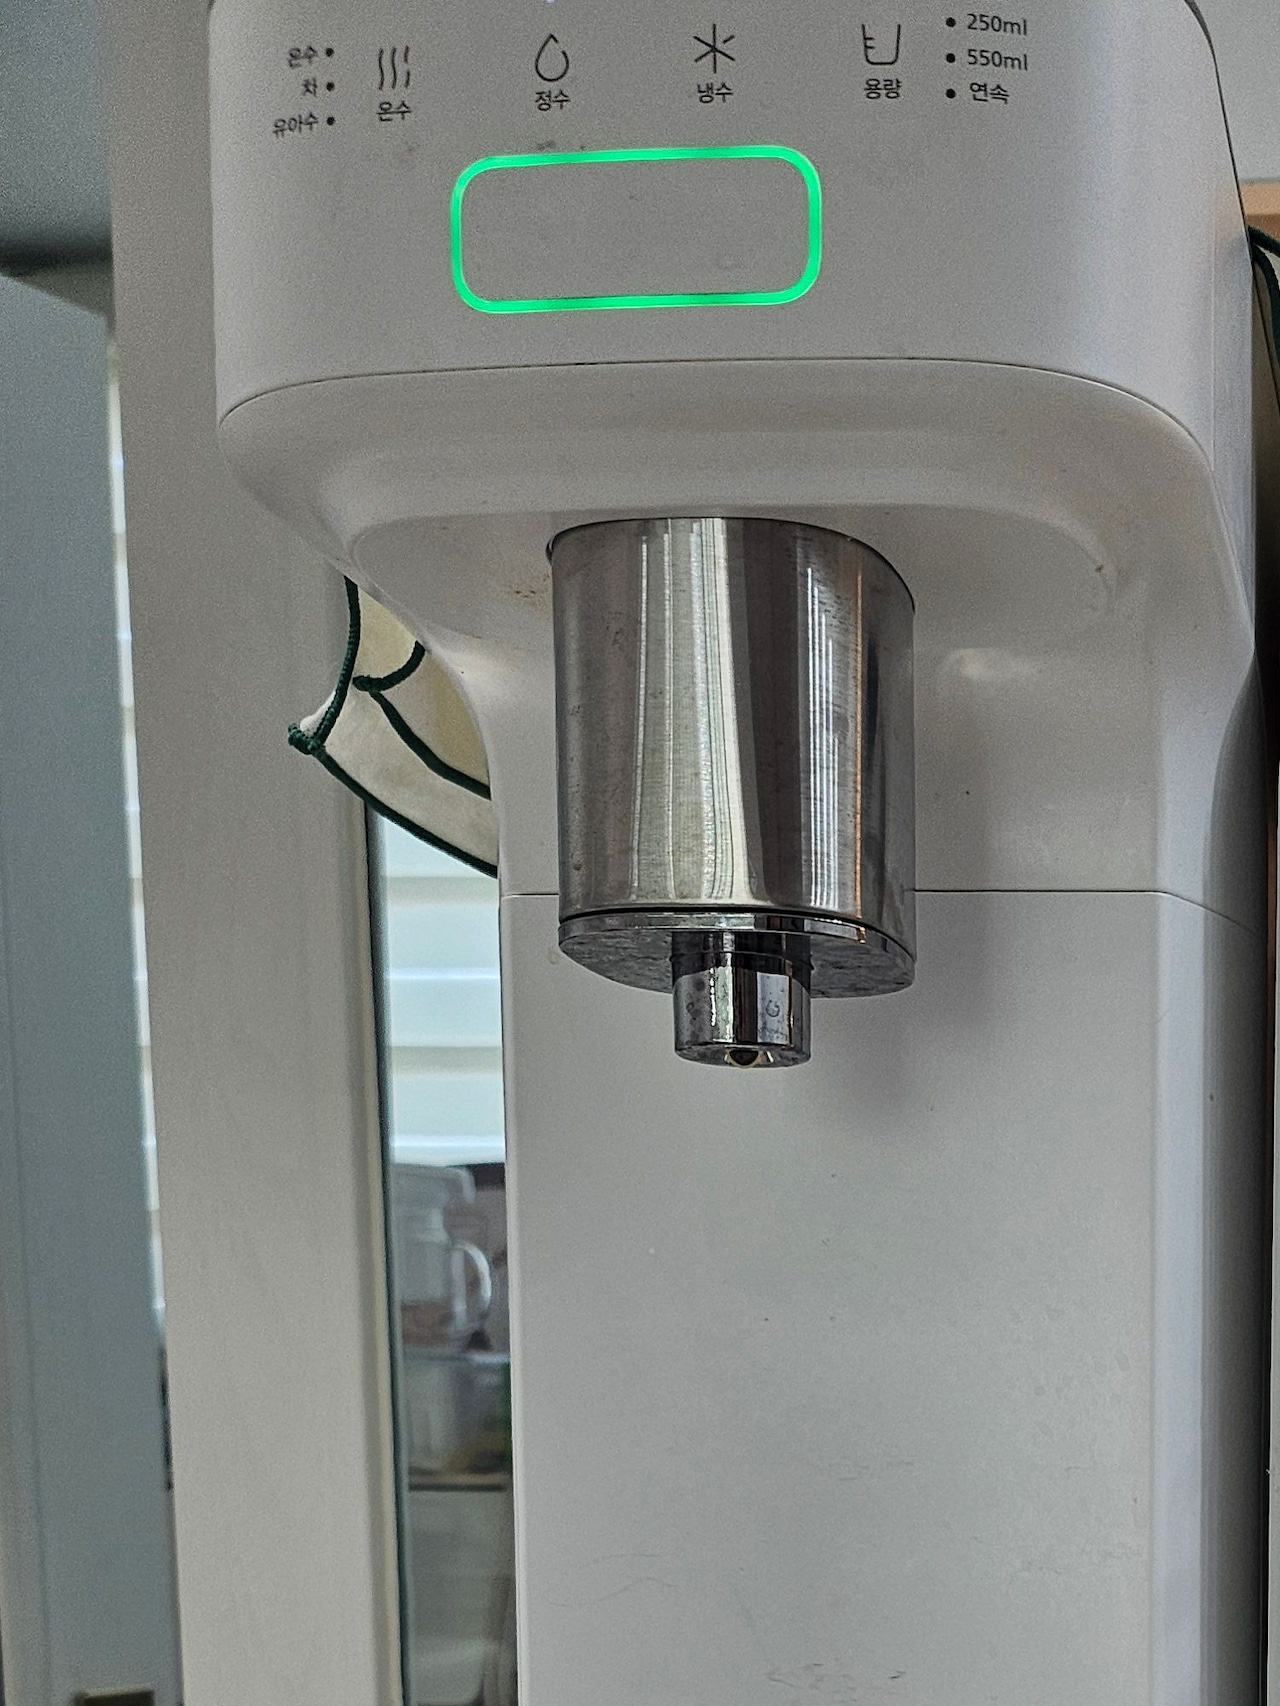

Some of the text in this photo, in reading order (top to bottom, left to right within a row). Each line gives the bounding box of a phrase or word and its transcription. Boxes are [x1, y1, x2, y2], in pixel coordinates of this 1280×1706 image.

[966, 13, 1028, 37] 250ml
[966, 48, 1029, 72] 550ml
[302, 78, 319, 97] 차
[697, 82, 735, 104] 냉수
[864, 78, 903, 100] 용량
[969, 81, 1011, 105] 연속
[376, 99, 413, 122] 온수
[535, 89, 572, 112] 정수
[272, 111, 319, 138] 유아수
